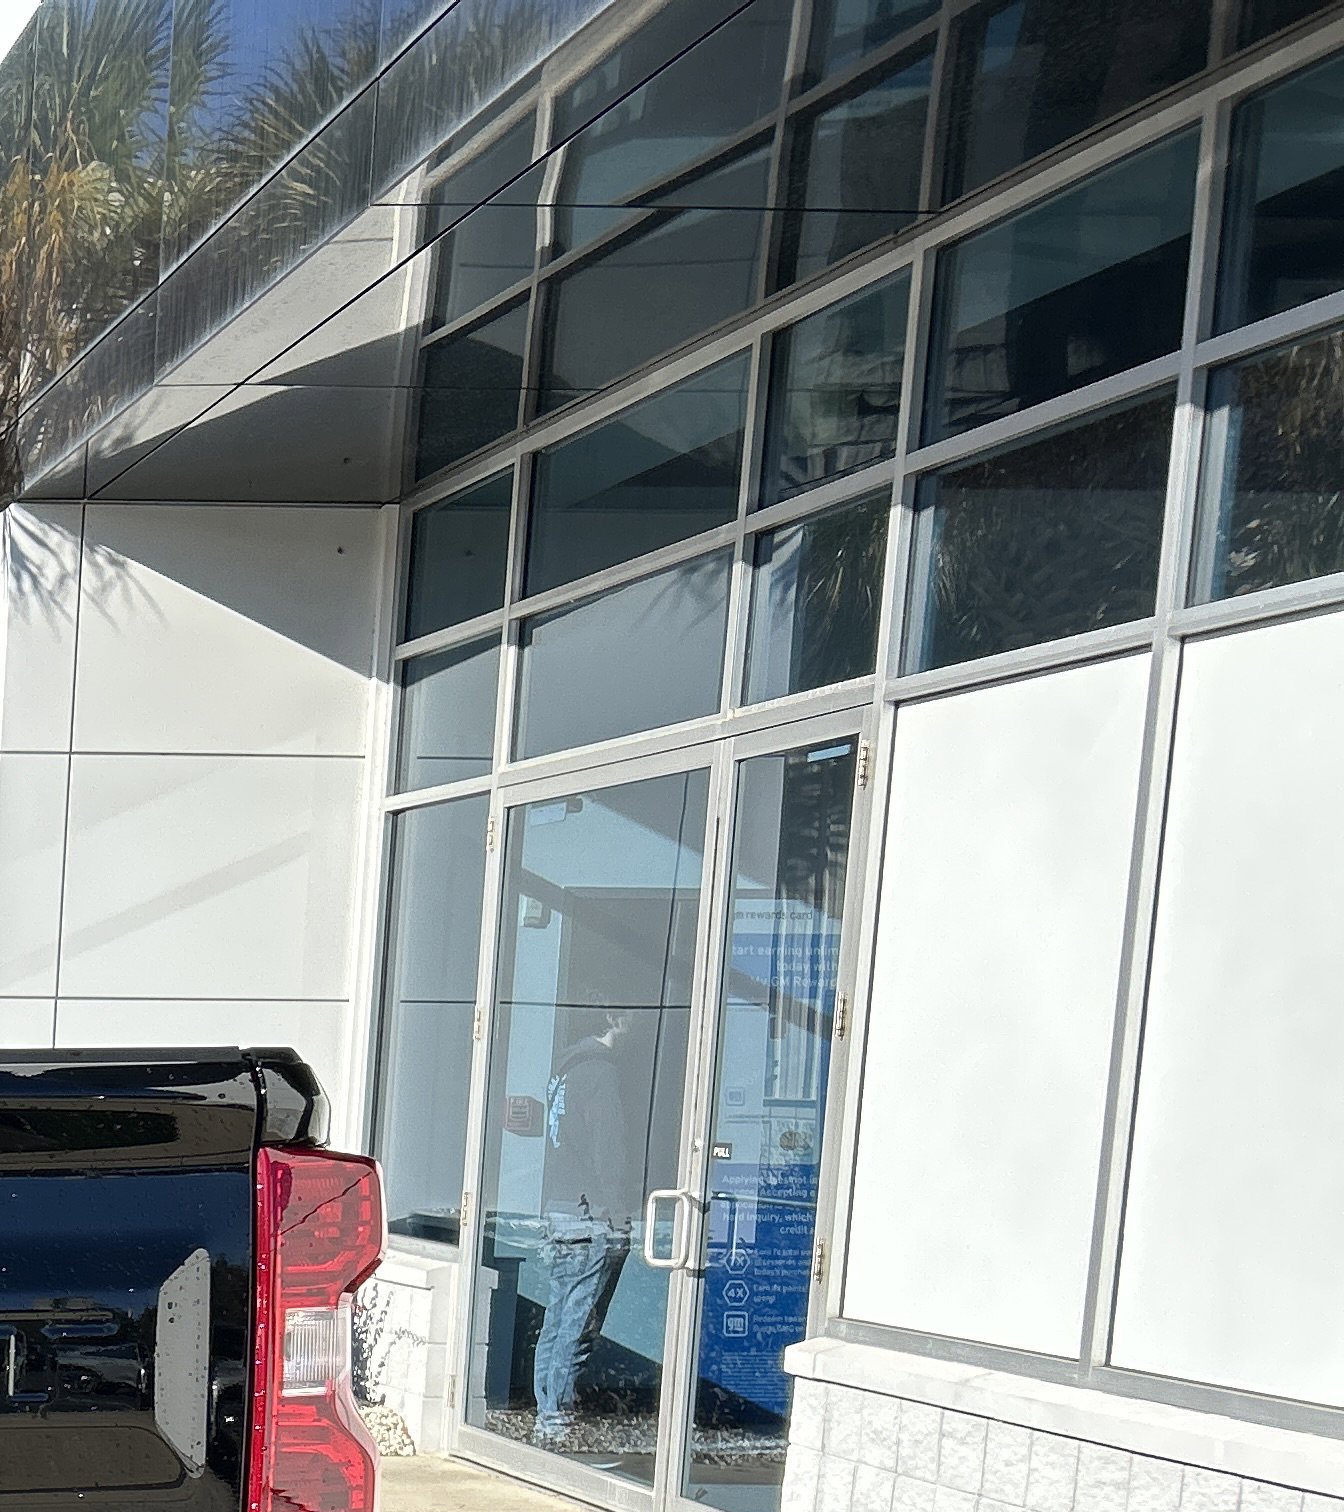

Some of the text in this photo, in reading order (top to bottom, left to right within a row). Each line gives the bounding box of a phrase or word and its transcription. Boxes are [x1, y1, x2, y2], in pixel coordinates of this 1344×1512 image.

[789, 910, 813, 920] card
[732, 944, 754, 955] tart
[713, 1146, 730, 1158] PULL
